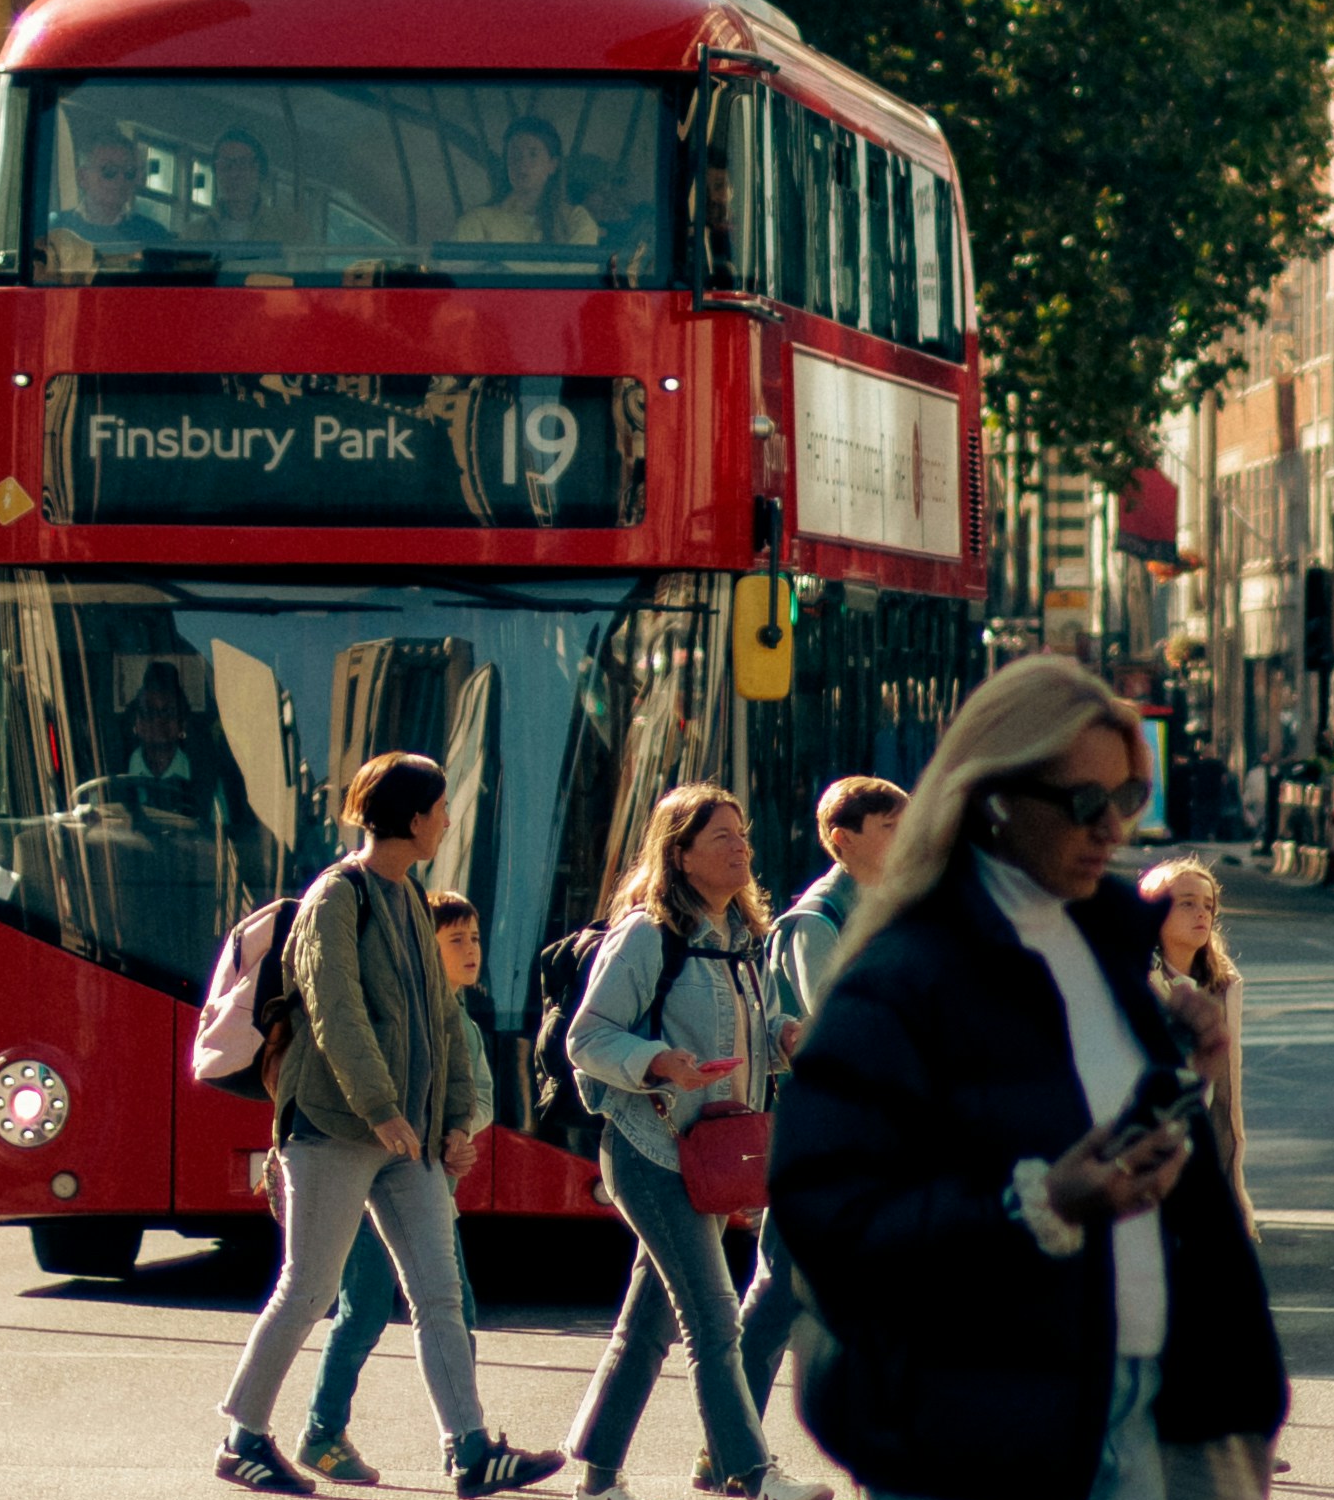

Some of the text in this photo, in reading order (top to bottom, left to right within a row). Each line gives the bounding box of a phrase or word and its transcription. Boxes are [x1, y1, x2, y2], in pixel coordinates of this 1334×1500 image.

[88, 414, 416, 472] Finsbury Park
[501, 403, 579, 485] 19
